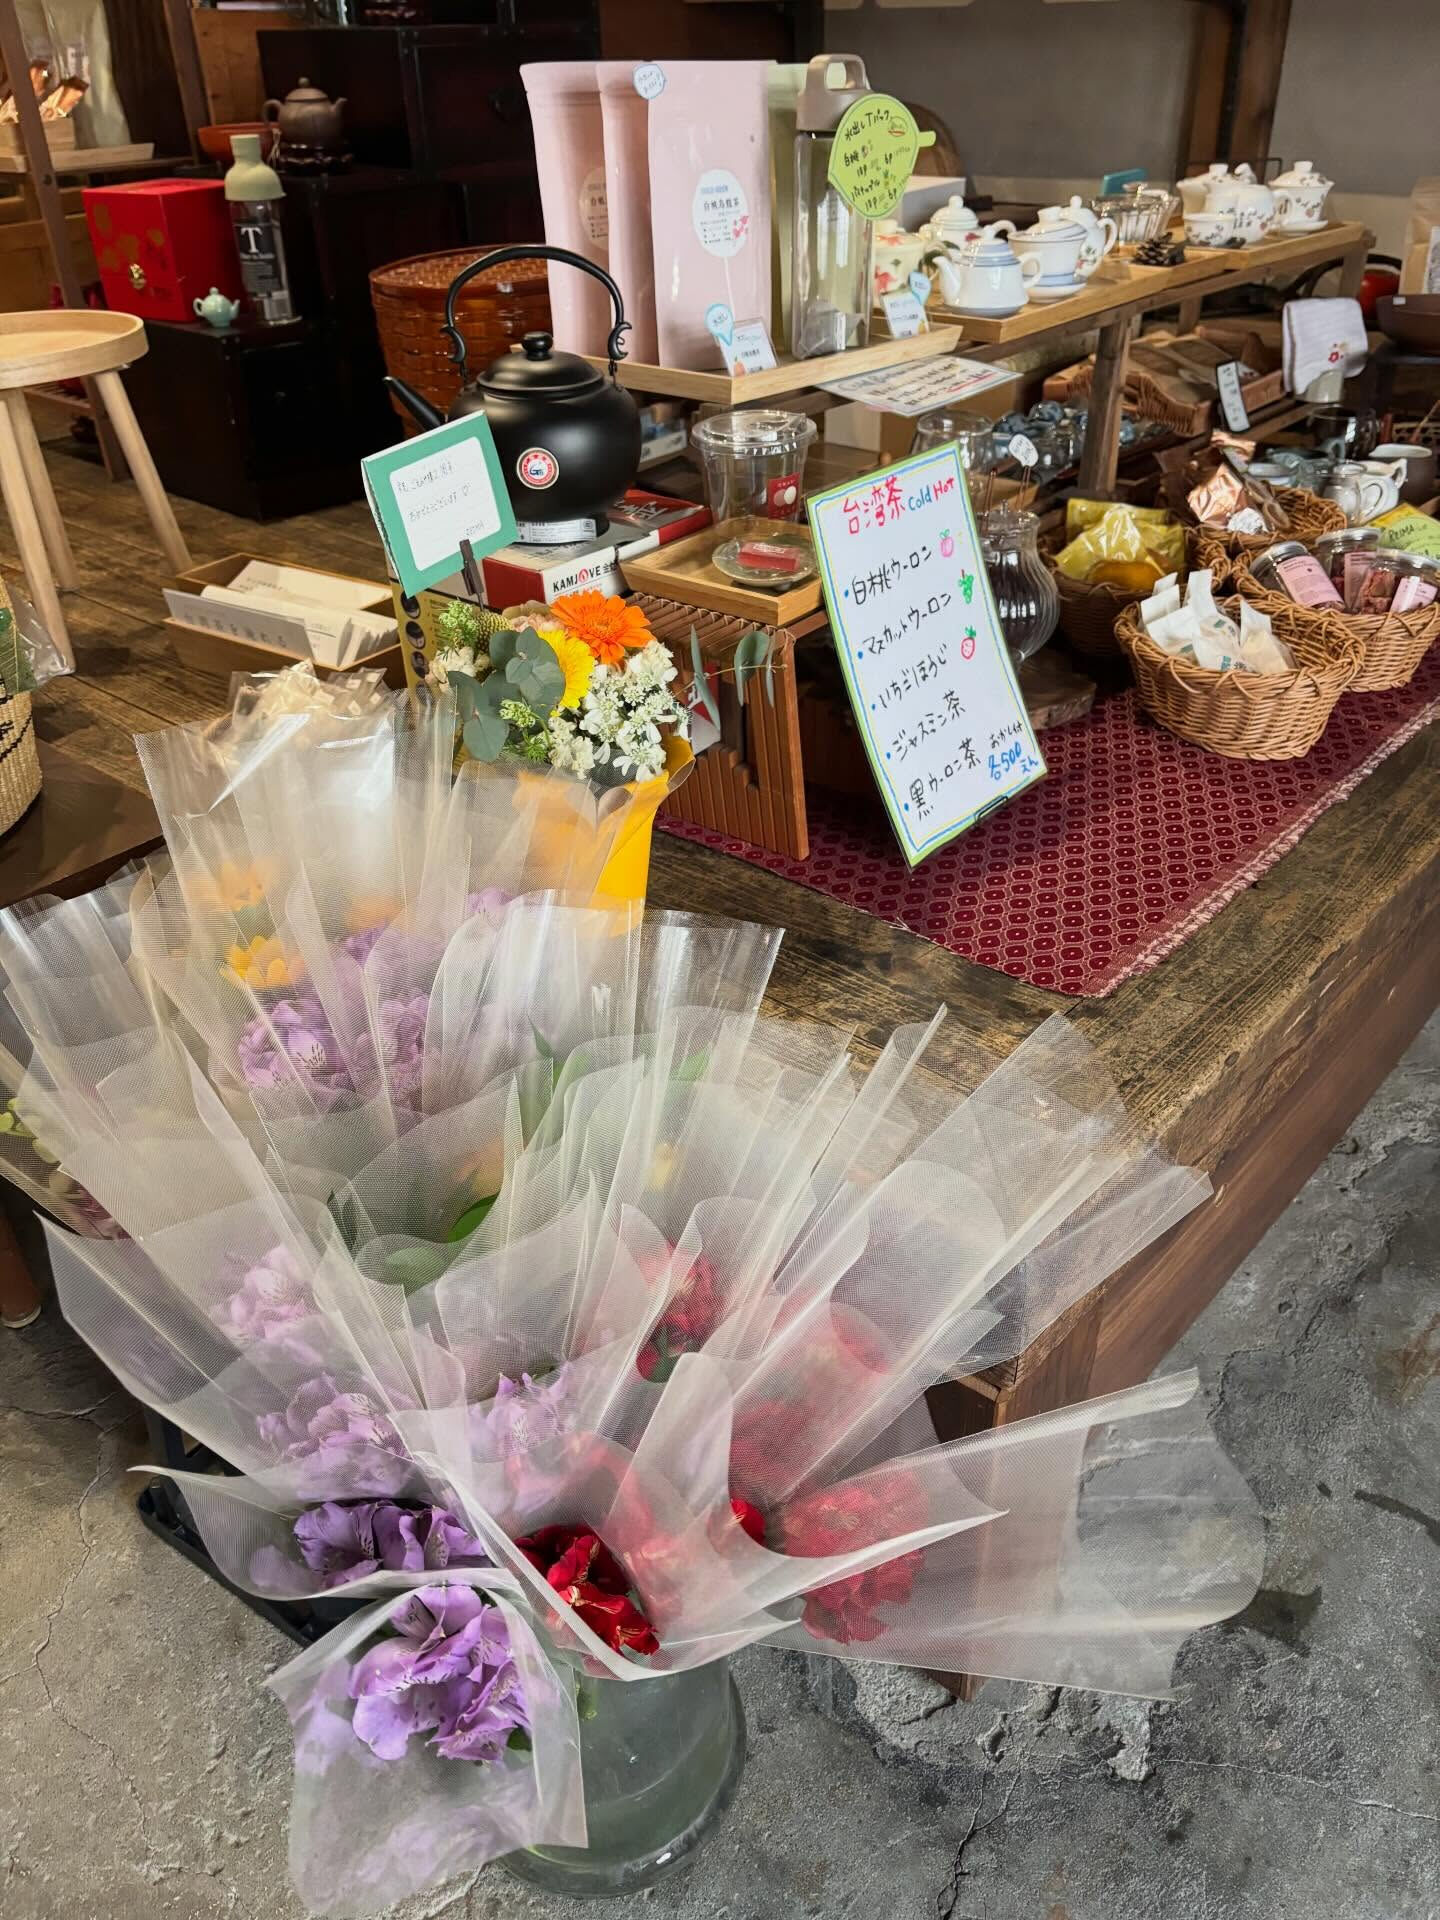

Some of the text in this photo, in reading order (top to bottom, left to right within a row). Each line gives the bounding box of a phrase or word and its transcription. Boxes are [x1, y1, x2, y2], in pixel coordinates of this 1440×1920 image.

[843, 475, 906, 535] 台湾茶
[851, 545, 932, 605] 白桃ウーロン
[862, 593, 952, 655] マスカットウーロン
